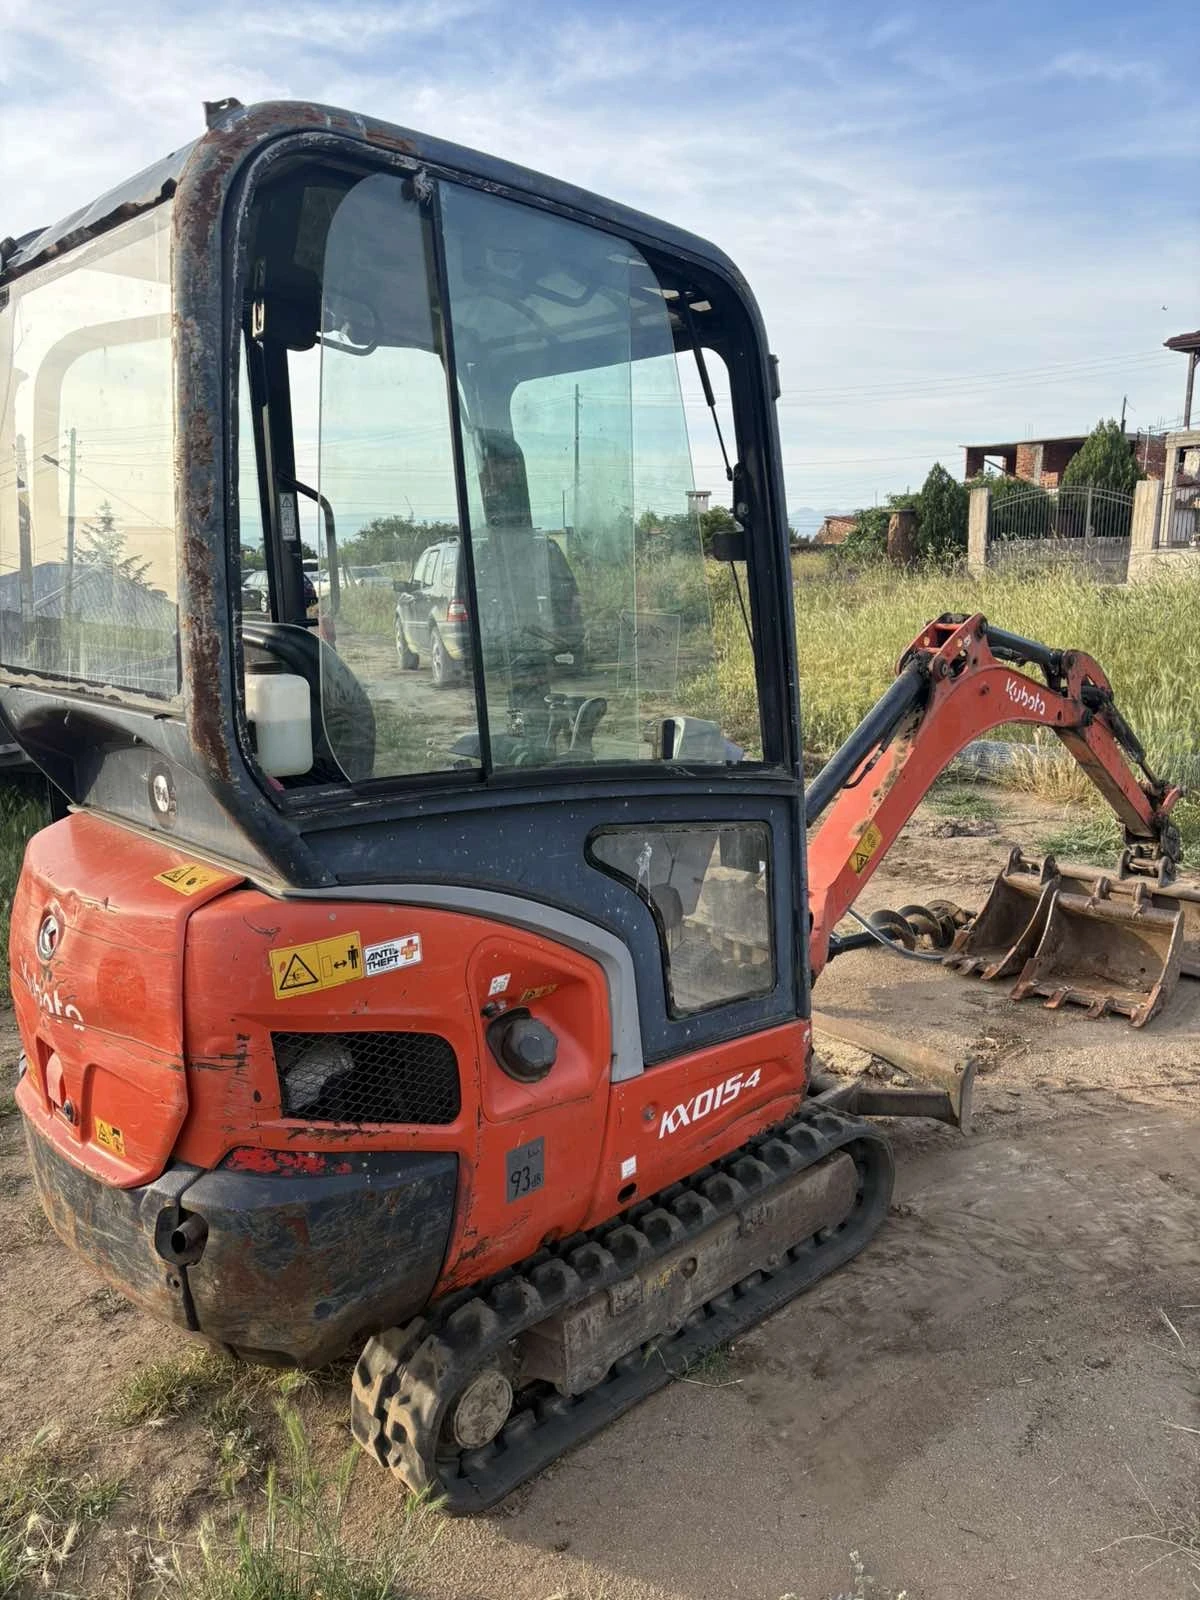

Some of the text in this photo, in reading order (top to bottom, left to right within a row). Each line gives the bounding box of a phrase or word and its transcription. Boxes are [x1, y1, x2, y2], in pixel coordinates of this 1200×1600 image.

[1006, 677, 1045, 715] Kubota
[366, 955, 399, 969] THEFT
[511, 1166, 530, 1197] 93
